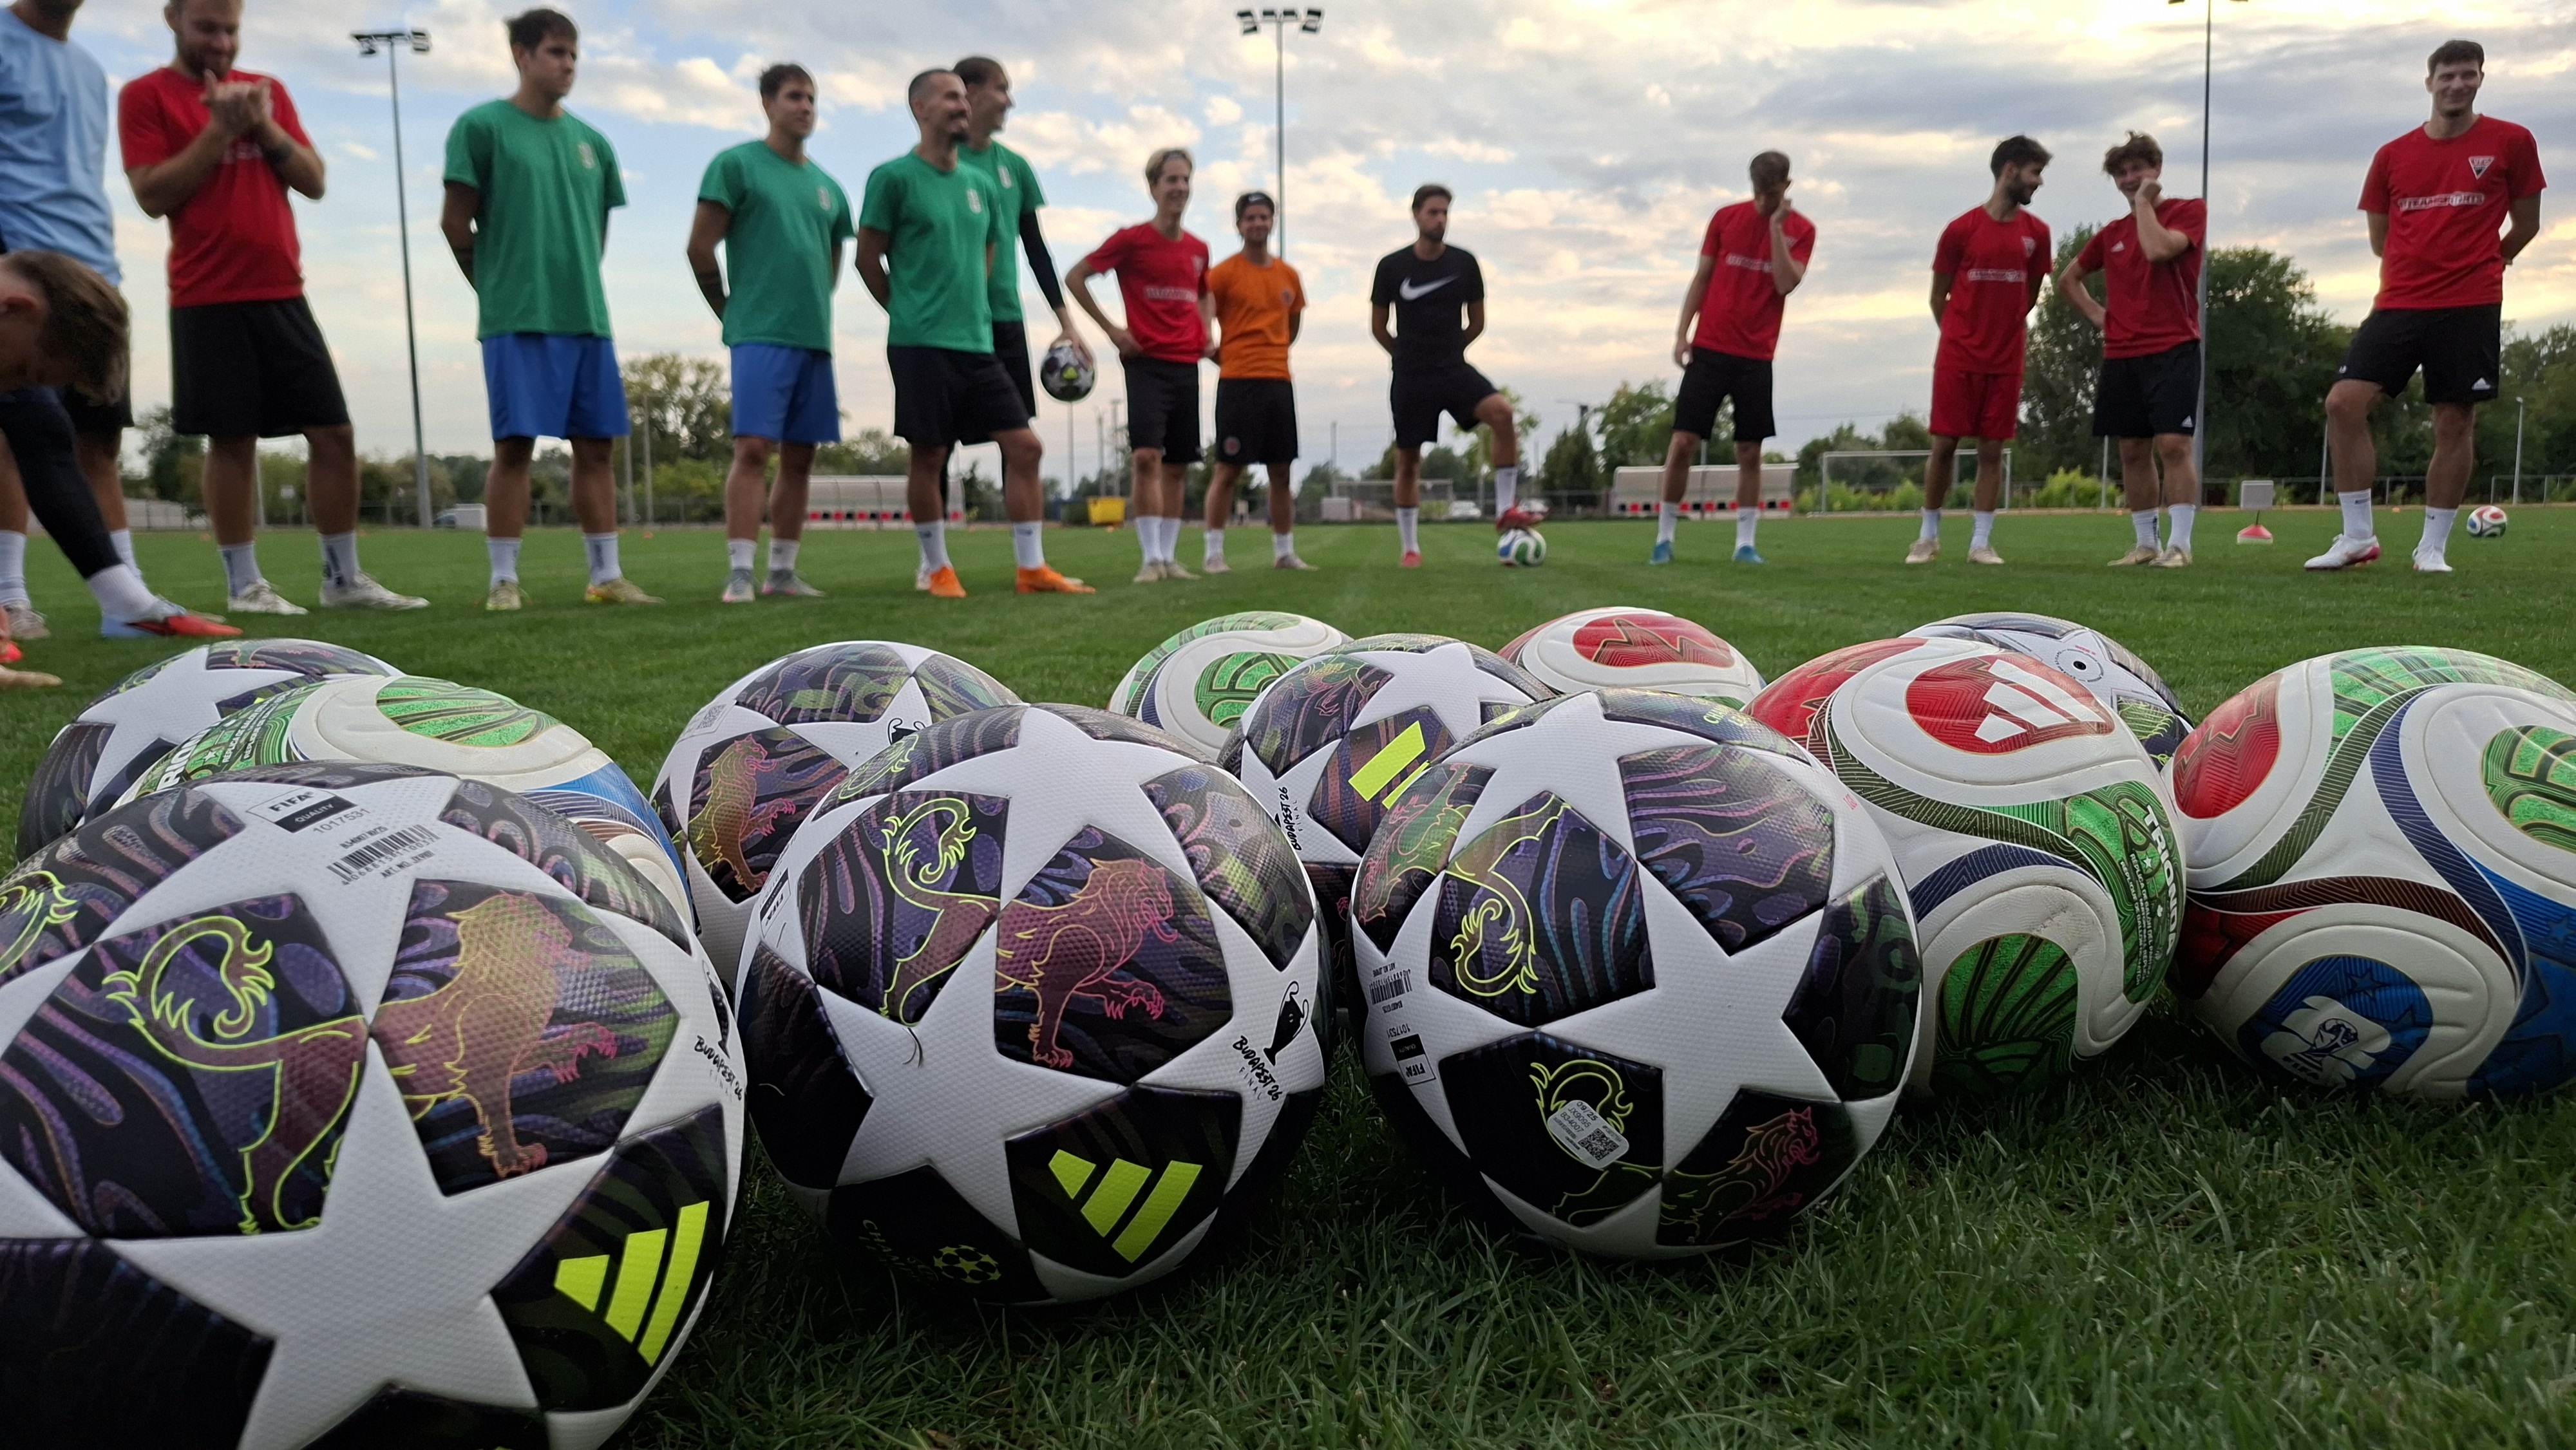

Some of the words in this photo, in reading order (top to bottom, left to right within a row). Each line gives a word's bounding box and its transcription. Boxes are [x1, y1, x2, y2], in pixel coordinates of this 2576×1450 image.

[1278, 787, 1289, 800] 26
[294, 804, 334, 822] QUALITY
[313, 808, 370, 833] 1017531
[1293, 800, 1303, 831] FINAL
[1280, 801, 1302, 851] BUDAPEST
[2145, 805, 2177, 956] TRIONDA
[1386, 1023, 1411, 1039] 1017531
[694, 1035, 736, 1087] BUDAPEST
[1233, 1035, 1276, 1088] BUDAPEST
[1267, 1084, 1283, 1101] 26
[1239, 1066, 1262, 1100] FINAL
[1560, 1111, 1584, 1132] B34007
[1568, 1107, 1591, 1127] JX9095
[1577, 1101, 1598, 1121] 09/25
